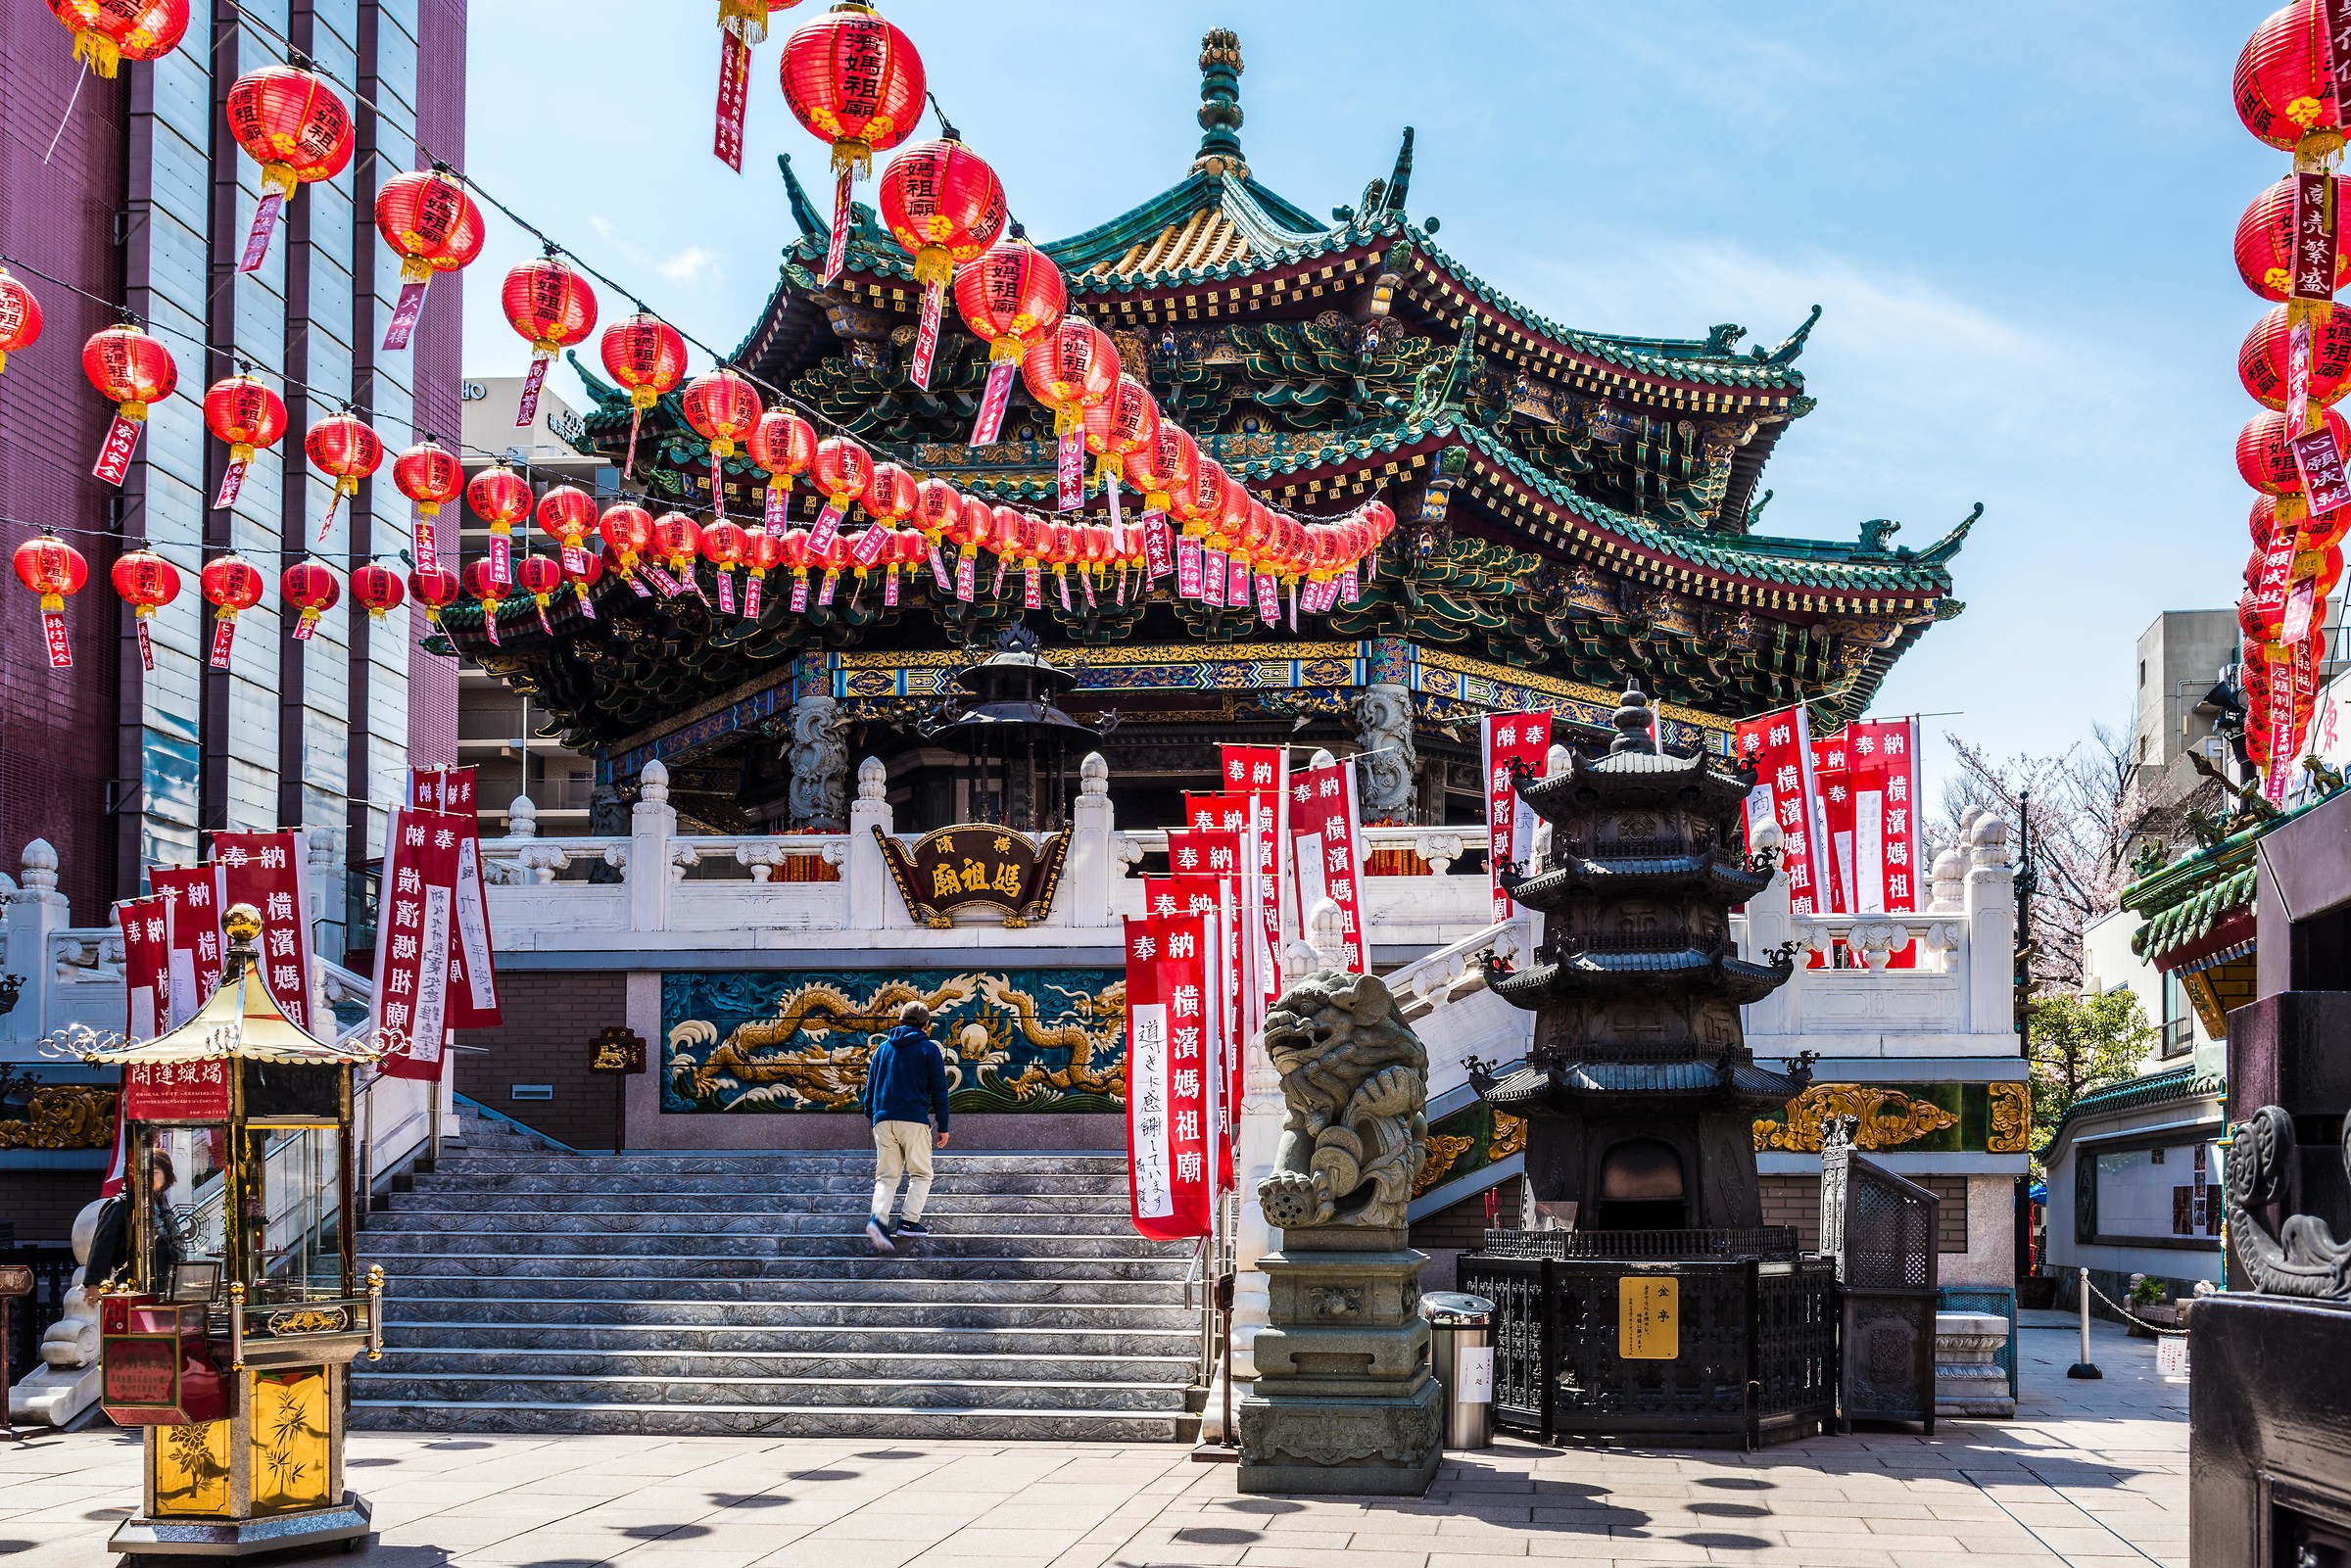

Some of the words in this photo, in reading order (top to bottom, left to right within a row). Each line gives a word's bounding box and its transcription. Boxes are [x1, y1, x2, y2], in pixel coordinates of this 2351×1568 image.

[2297, 183, 2331, 295] 商売繁盛
[99, 424, 135, 480] 家内安全
[2300, 436, 2348, 507] 心願成就
[1060, 441, 1080, 508] 商売繁盛
[1146, 518, 1170, 575] 商売繁盛
[1180, 545, 1200, 595] 除災招福
[1205, 556, 1223, 602] 商売繁盛
[2257, 535, 2294, 605] 心願成就
[48, 618, 71, 663] 旅行安全
[213, 623, 231, 667] ヒット祈願
[1742, 724, 1791, 752] 奉納
[1855, 734, 1904, 756] 奉納
[2323, 696, 2339, 753] 東
[1227, 759, 1272, 785] 奉納
[1294, 777, 1339, 804] 奉納
[1193, 809, 1243, 833] 奉納
[223, 845, 286, 870] 奉納
[1177, 846, 1233, 871] 奉納
[158, 881, 211, 907] 奉納
[1153, 892, 1214, 919] 奉納
[126, 917, 166, 944] 奉納
[1132, 931, 1195, 962] 奉納
[266, 891, 305, 1026] 横濱媽祖
[1173, 984, 1202, 1184] 横濱媽祖廟
